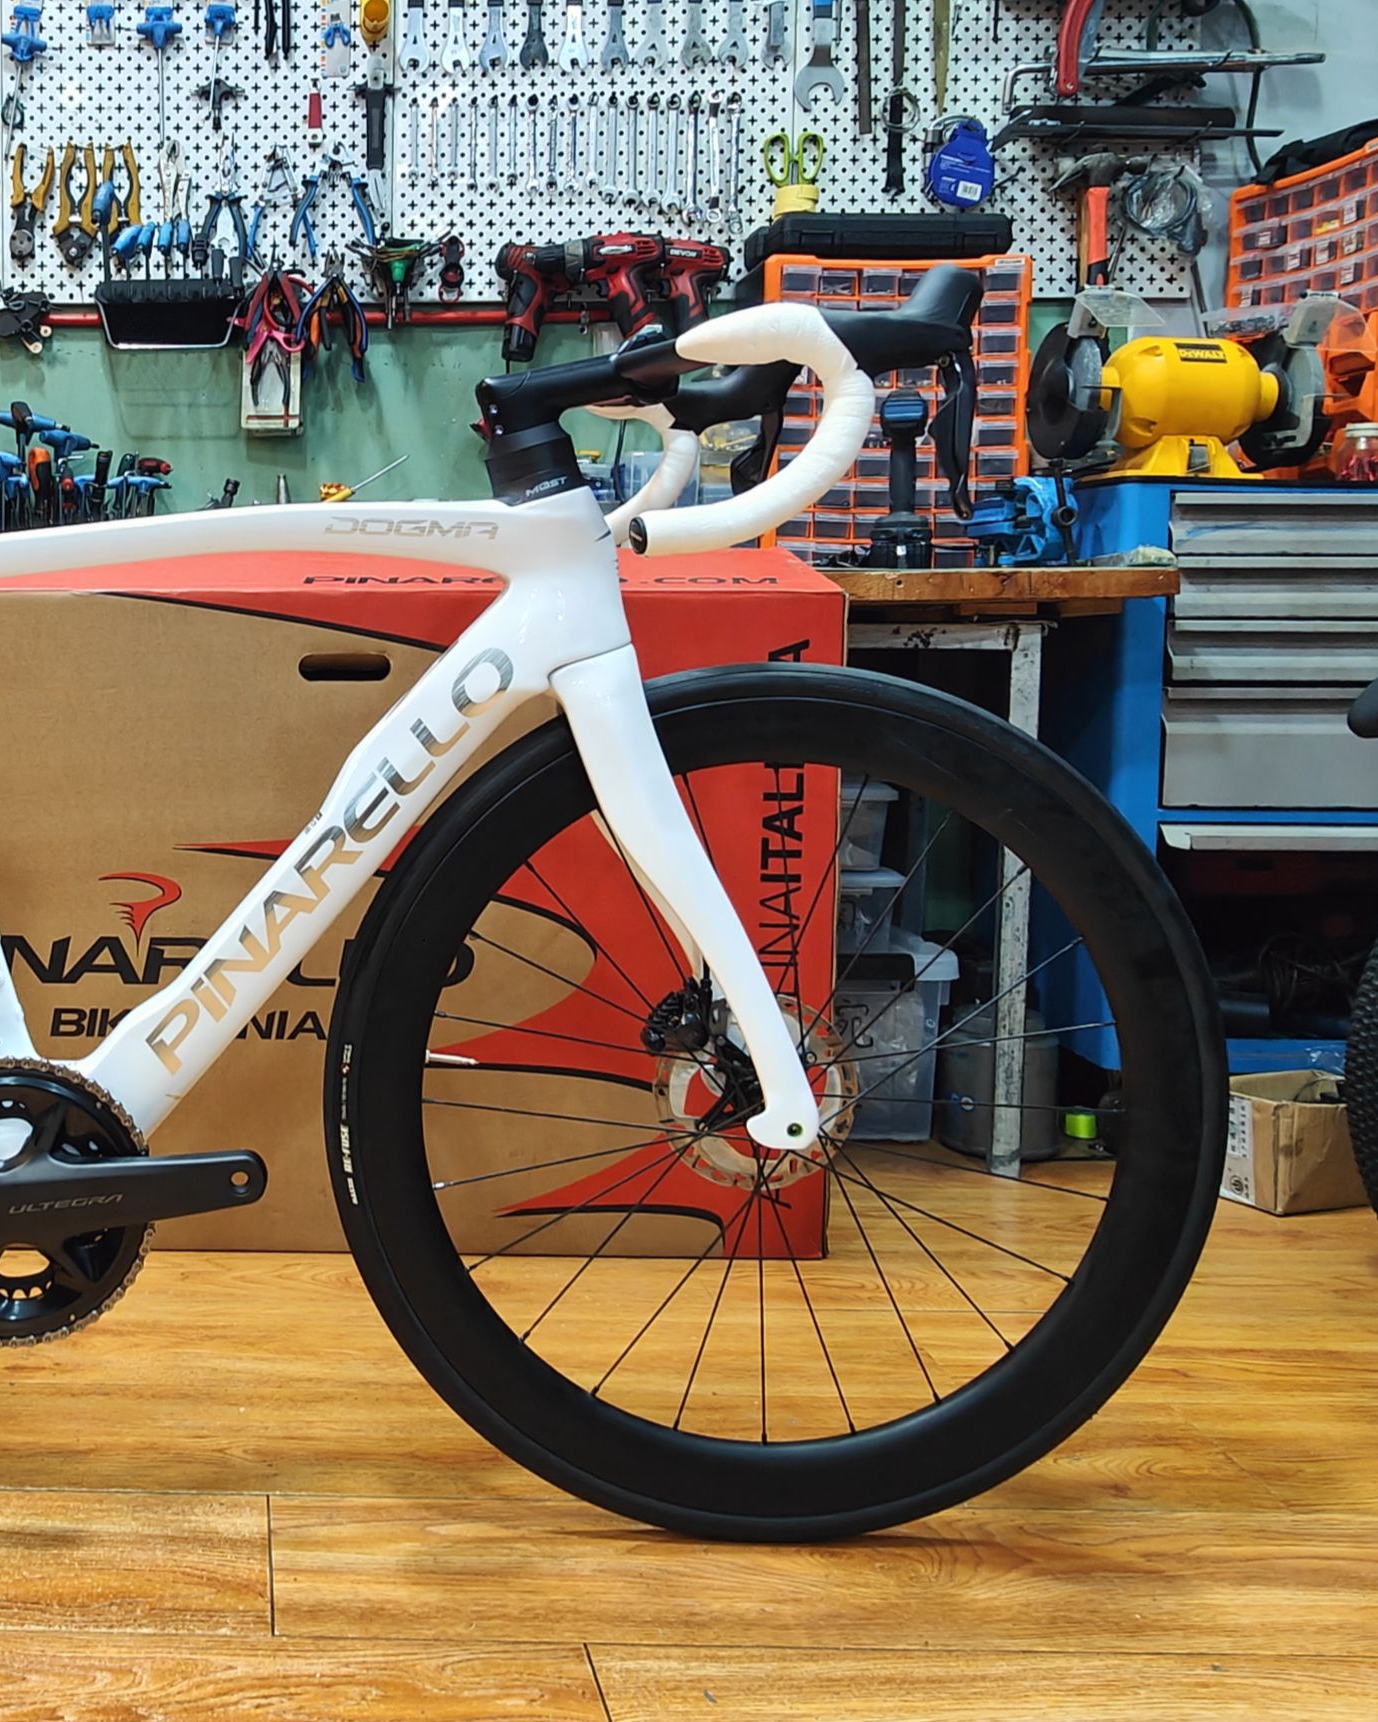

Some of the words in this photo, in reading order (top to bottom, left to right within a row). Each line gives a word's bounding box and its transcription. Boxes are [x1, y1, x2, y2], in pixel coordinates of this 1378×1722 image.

[324, 516, 498, 541] DOGMA
[145, 647, 515, 1076] PINARELLO
[9, 1194, 123, 1214] ULTEGRA
